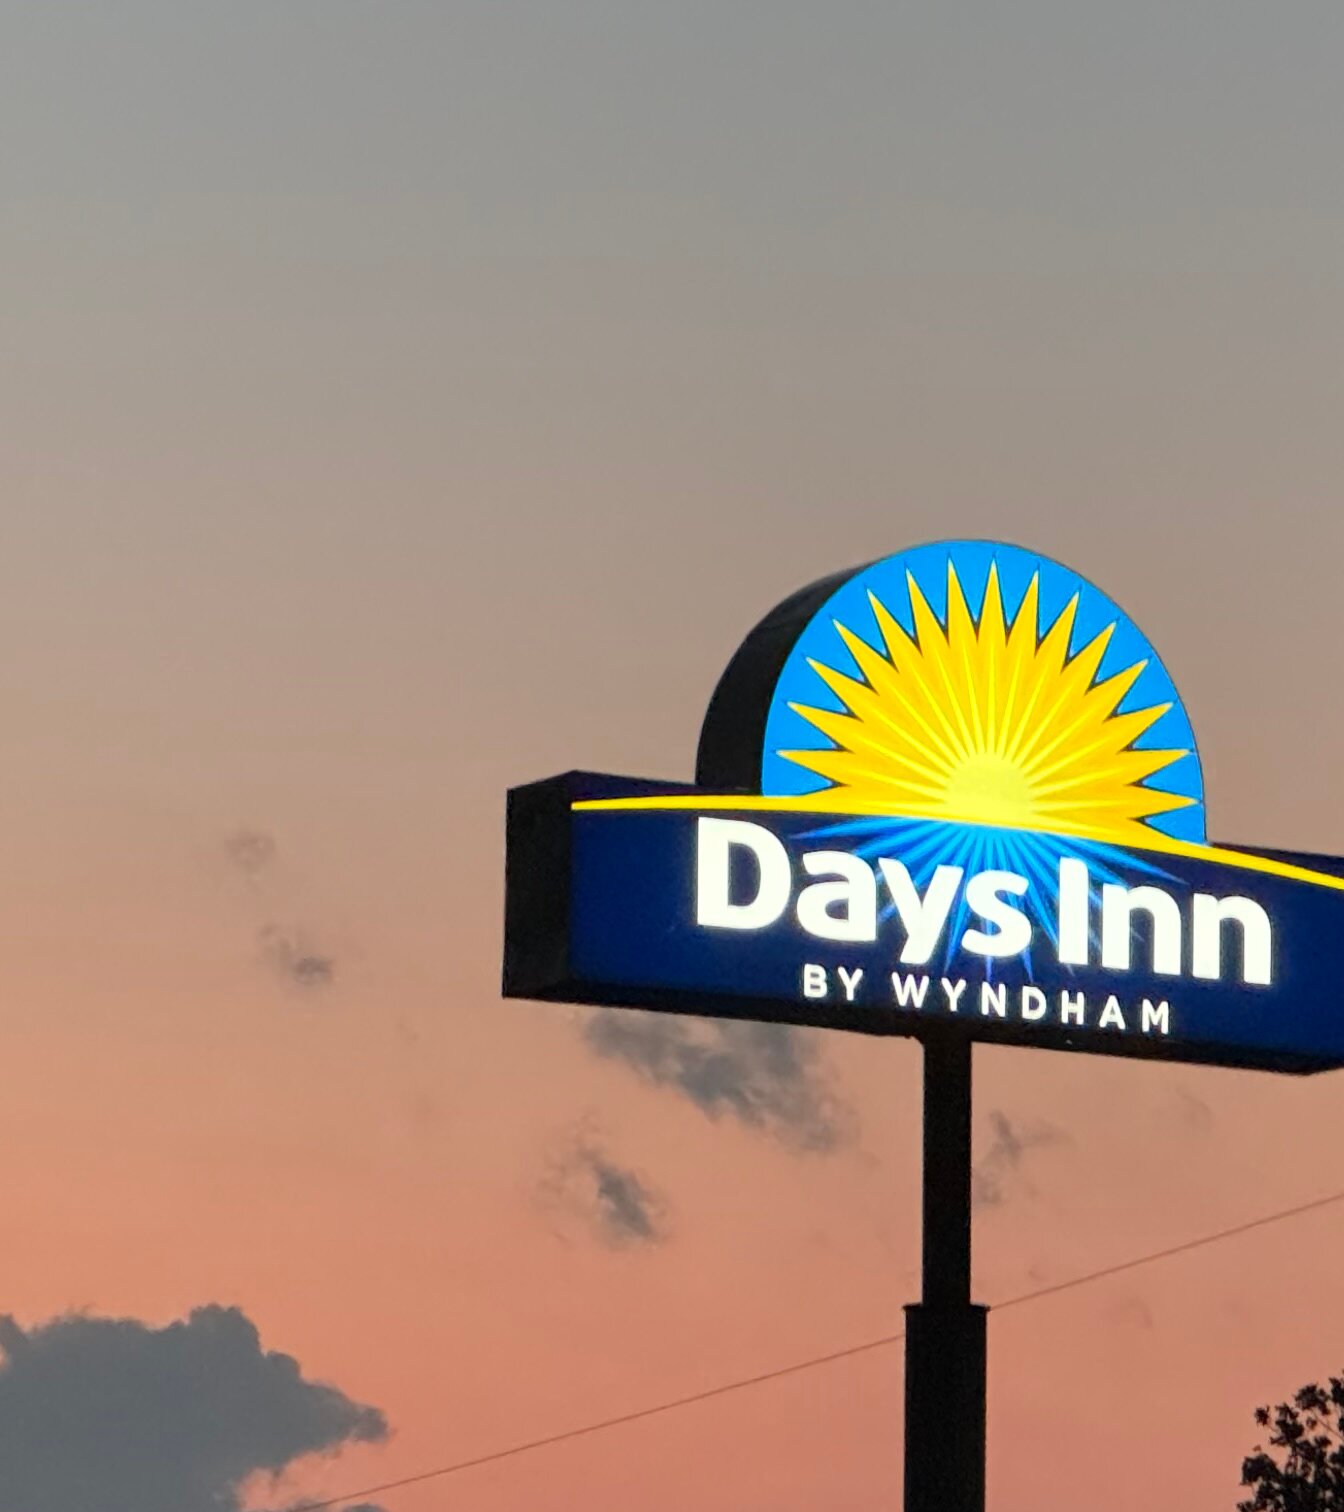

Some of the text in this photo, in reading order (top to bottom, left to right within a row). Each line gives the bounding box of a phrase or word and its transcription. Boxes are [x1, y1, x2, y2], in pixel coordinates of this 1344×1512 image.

[696, 816, 1273, 986] Days Inn
[803, 963, 1169, 1035] BY WYNDHAM
